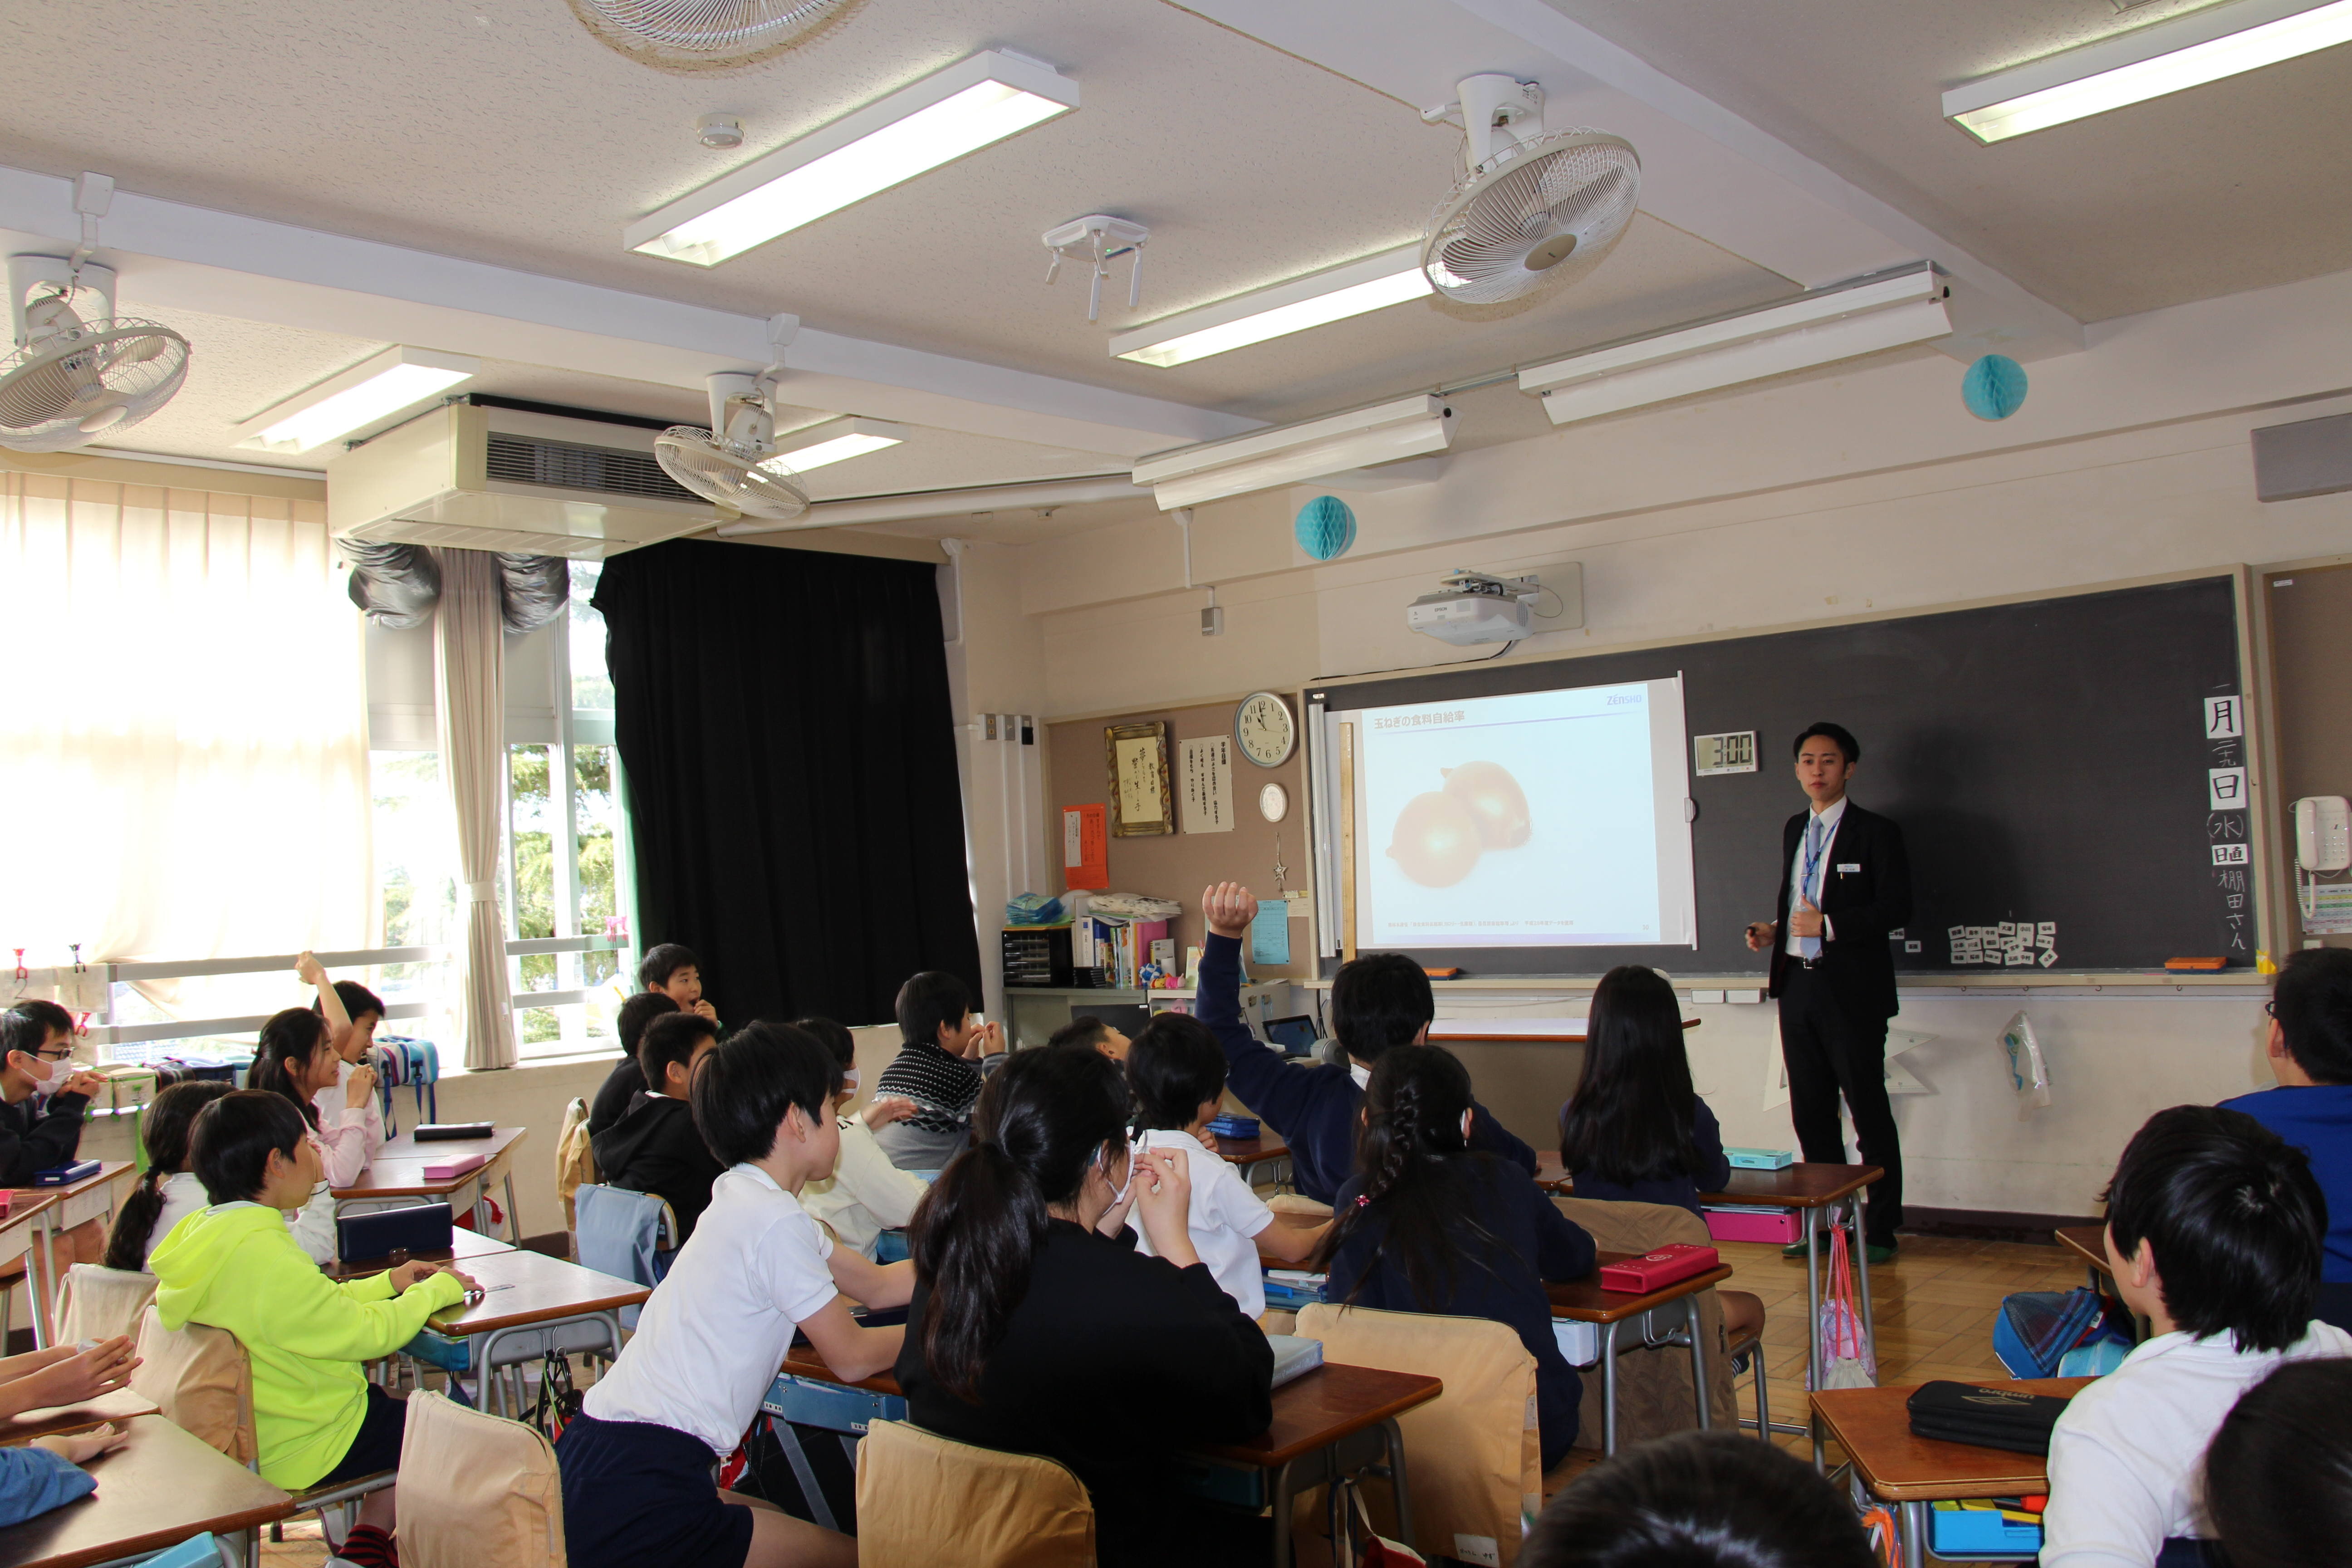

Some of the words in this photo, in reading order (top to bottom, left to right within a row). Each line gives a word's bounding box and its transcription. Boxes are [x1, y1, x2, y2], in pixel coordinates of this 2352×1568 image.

[1250, 705, 1256, 714] 11
[1259, 701, 1266, 710] 12
[1271, 703, 1274, 712] 1
[1245, 715, 1252, 724] 10
[1278, 711, 1283, 720] 2
[1374, 710, 1465, 729] 玉ねぎの食料自給率
[1243, 727, 1249, 736] 9
[1283, 723, 1288, 732] 3
[1249, 740, 1254, 748] 8
[1281, 736, 1286, 745] 4
[1256, 748, 1261, 757] 7
[1265, 750, 1271, 758] 6
[1275, 746, 1280, 755] 5
[1713, 734, 1751, 766] 3:00
[2214, 846, 2244, 863] 日直
[15, 977, 33, 1000] 2
[1979, 1387, 2035, 1399] umbro
